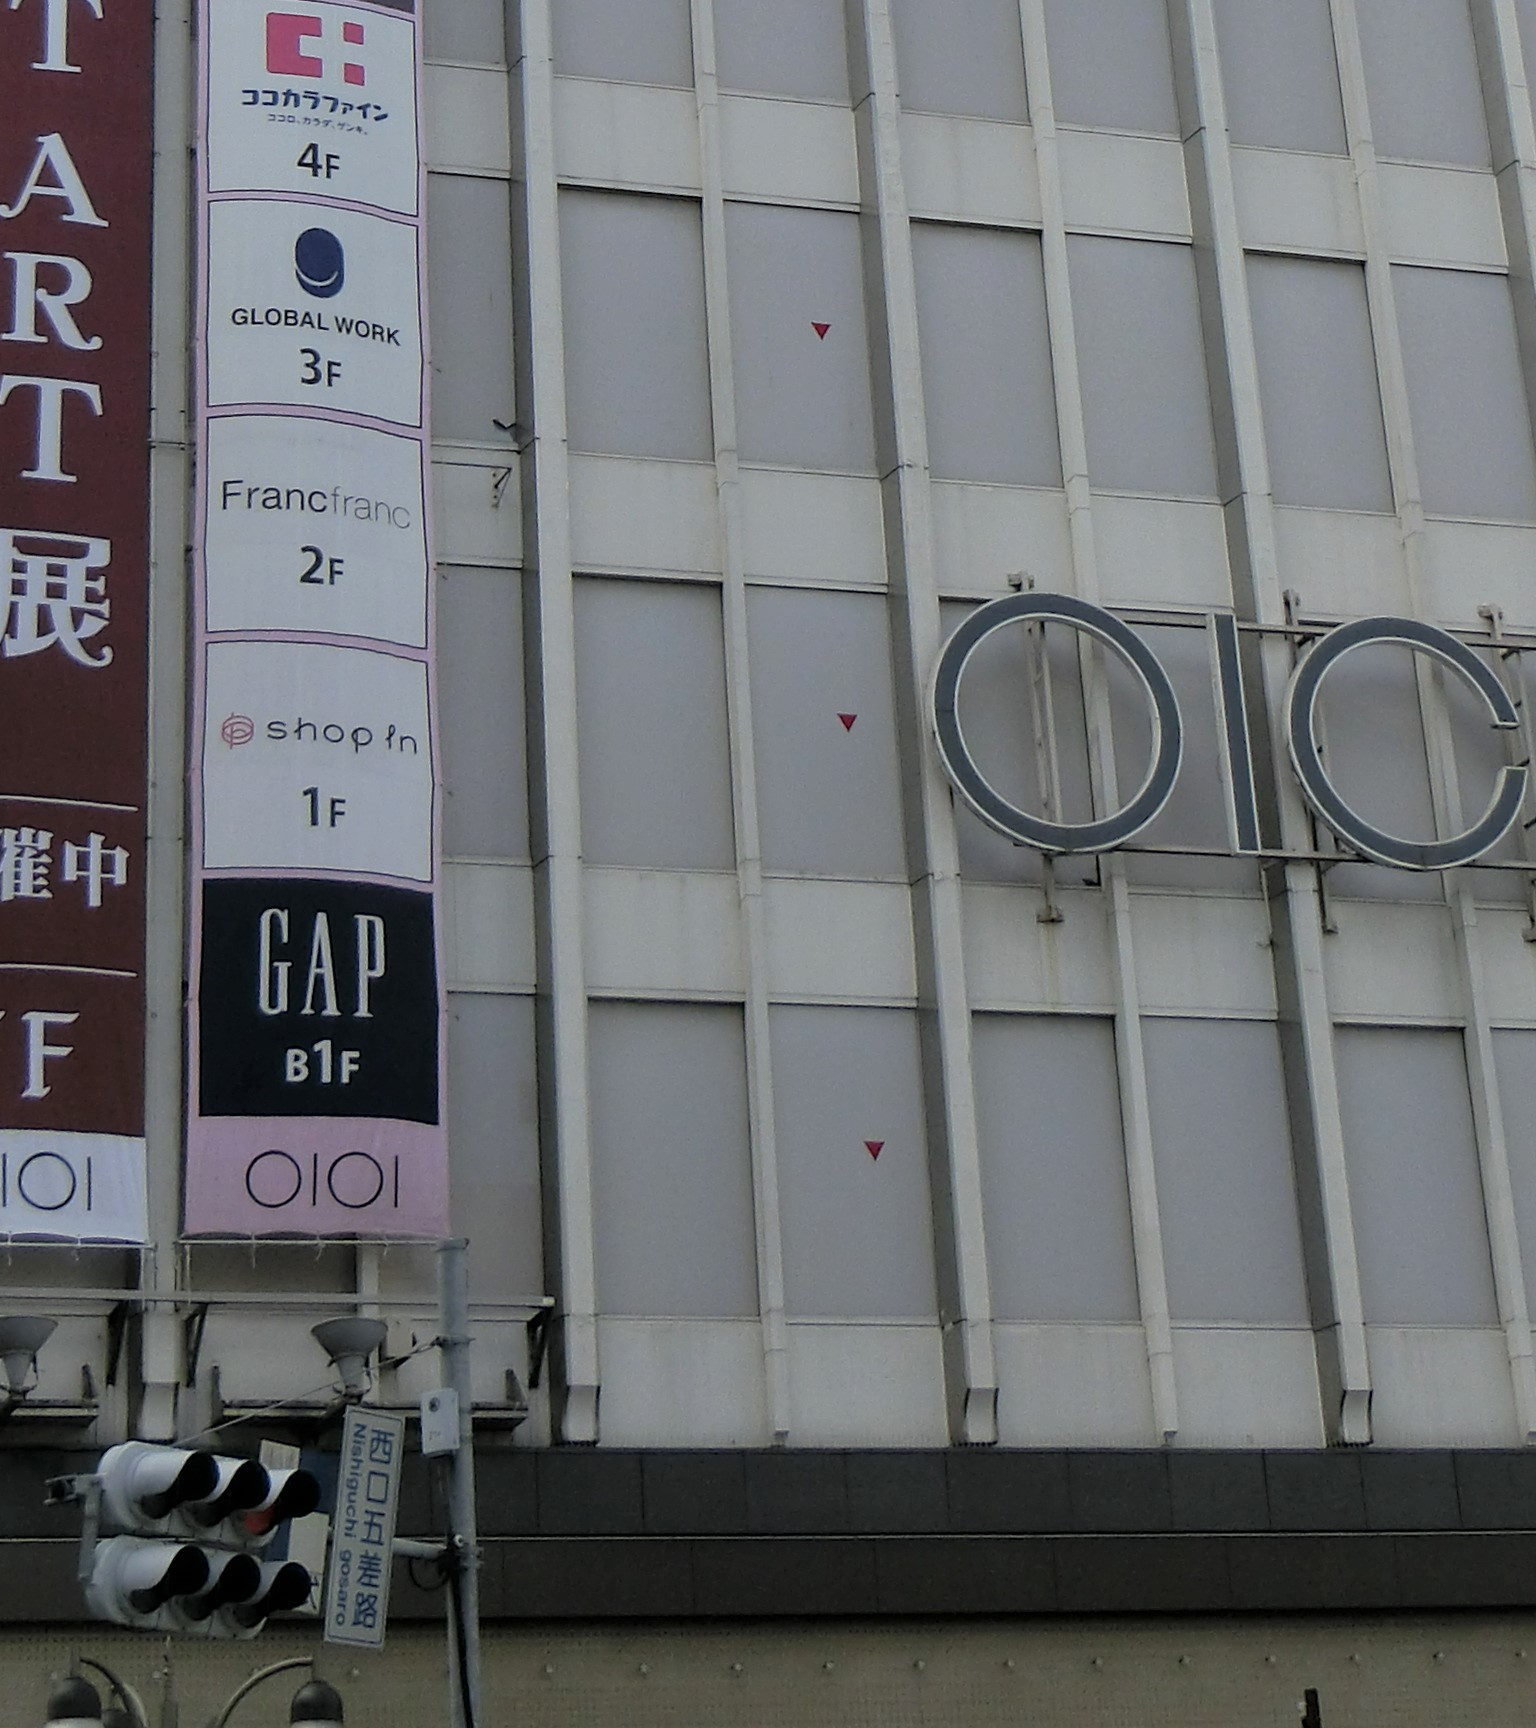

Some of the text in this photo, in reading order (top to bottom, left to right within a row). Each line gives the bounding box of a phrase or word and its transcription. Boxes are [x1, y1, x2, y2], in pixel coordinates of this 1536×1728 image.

[242, 89, 389, 121] ココカラファイン
[297, 142, 340, 179] 4F
[231, 308, 401, 347] GLOBAL WORK
[300, 348, 342, 388] 3F
[220, 479, 412, 531] Francfranc
[299, 545, 344, 586] 2F
[266, 716, 374, 753] shop
[302, 787, 347, 829] 1F
[258, 907, 385, 1018] GAP
[285, 1039, 361, 1085] B1F
[335, 1423, 367, 1627] Nishiguchi gosaro
[350, 1427, 396, 1629] 西口五差路
